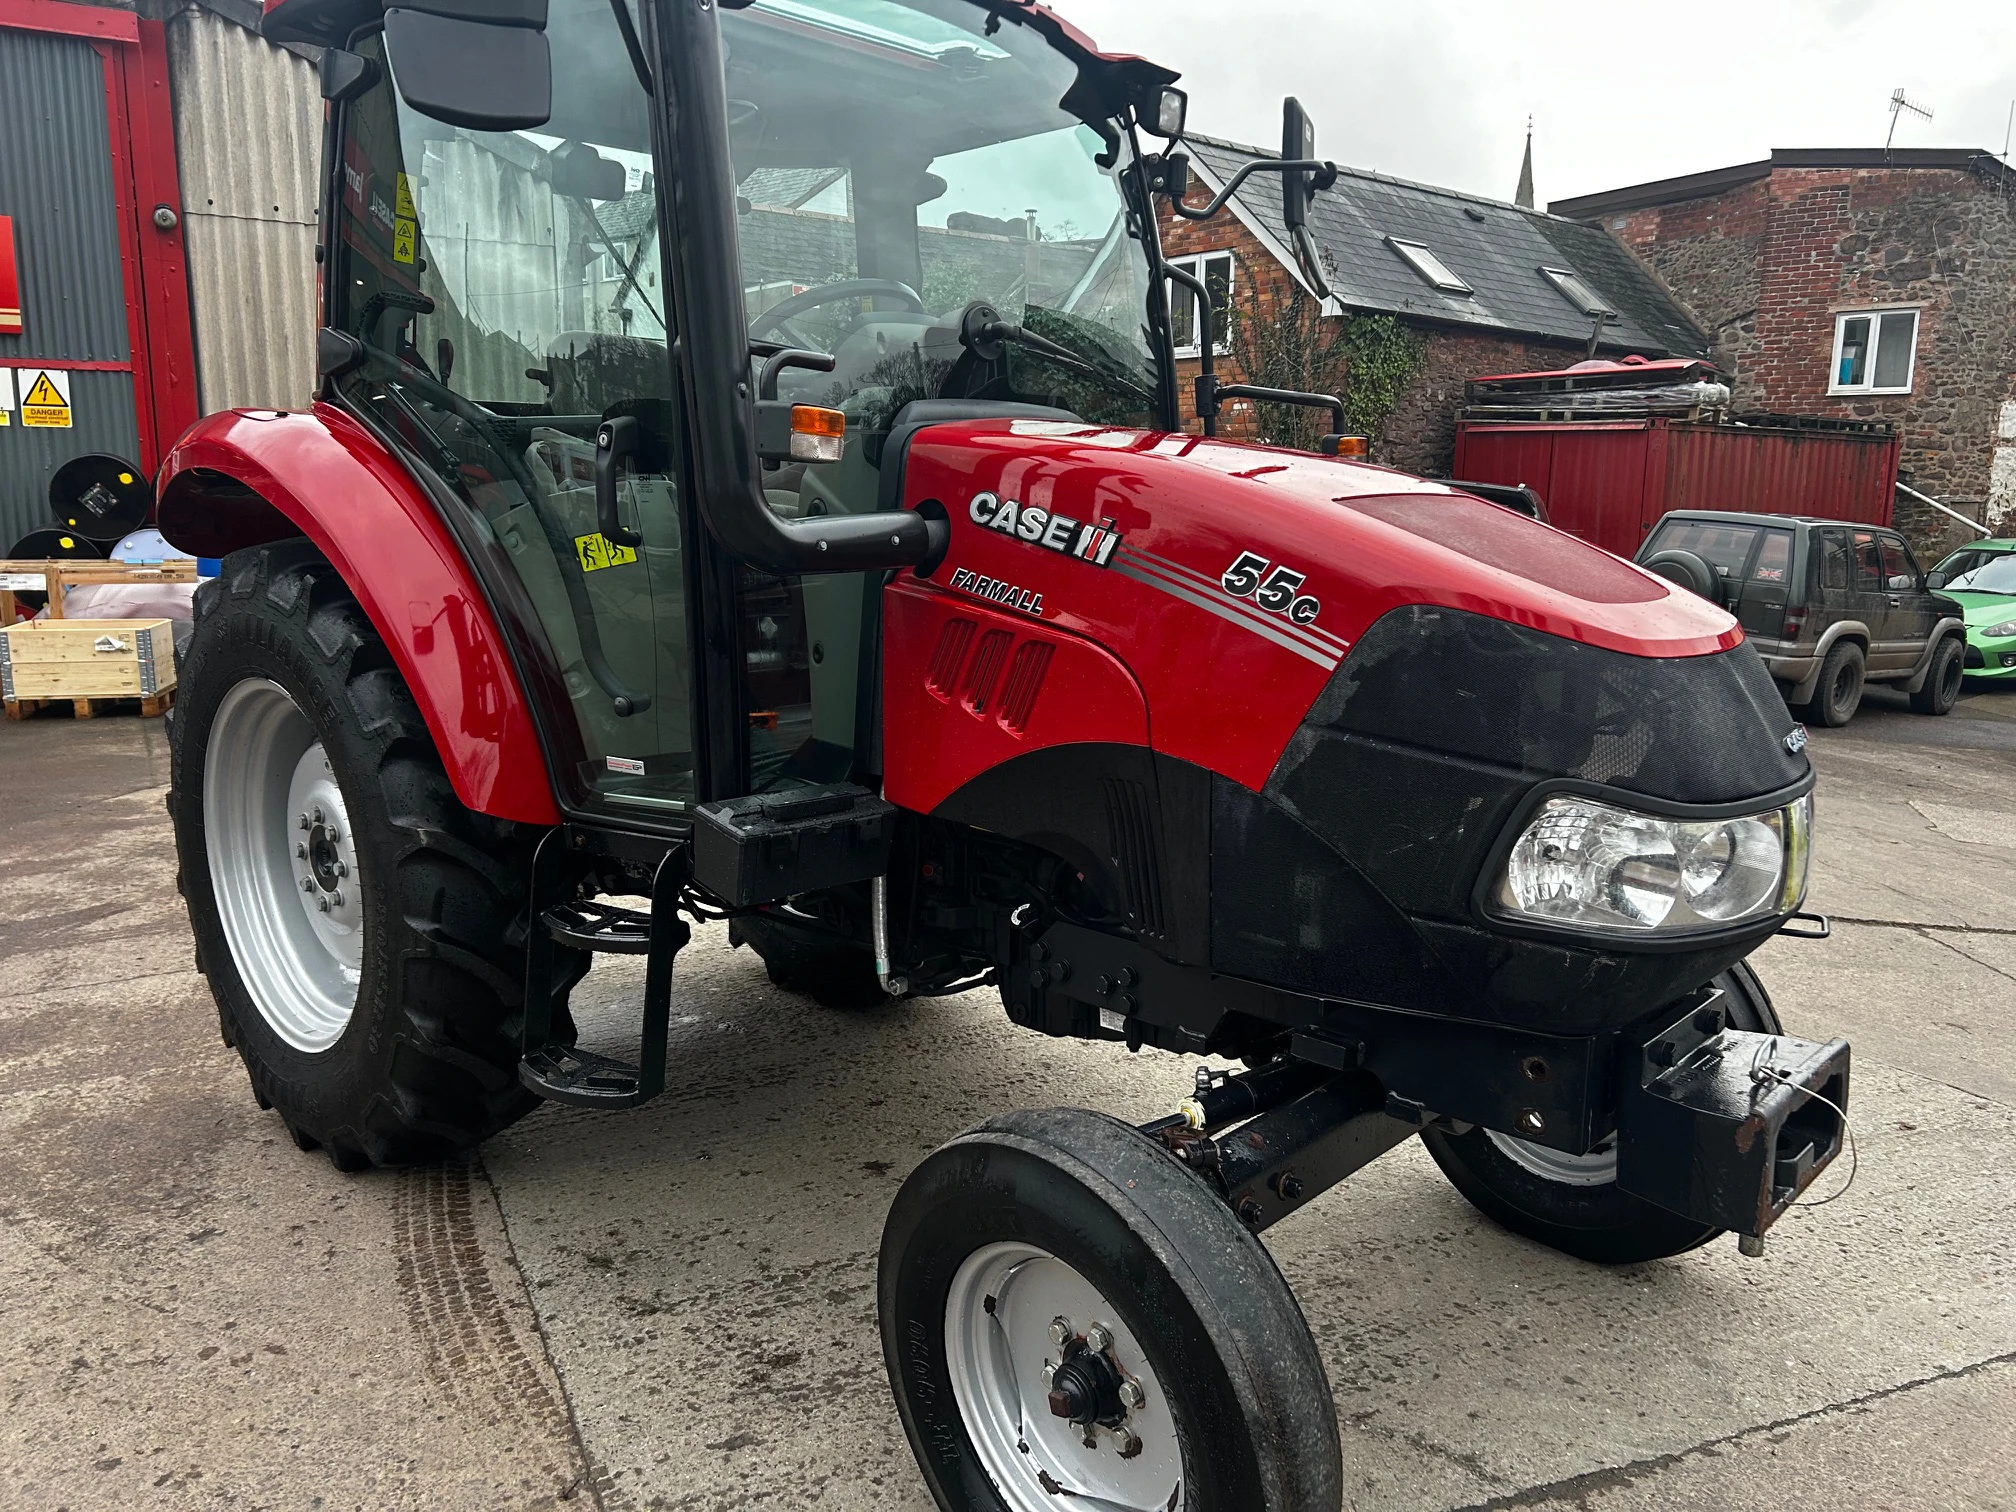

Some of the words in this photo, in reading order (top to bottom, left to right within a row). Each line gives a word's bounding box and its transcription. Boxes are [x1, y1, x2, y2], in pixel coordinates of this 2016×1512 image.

[30, 408, 63, 416] DANGER
[969, 490, 1079, 552] CASE
[949, 567, 1044, 617] FARMALL
